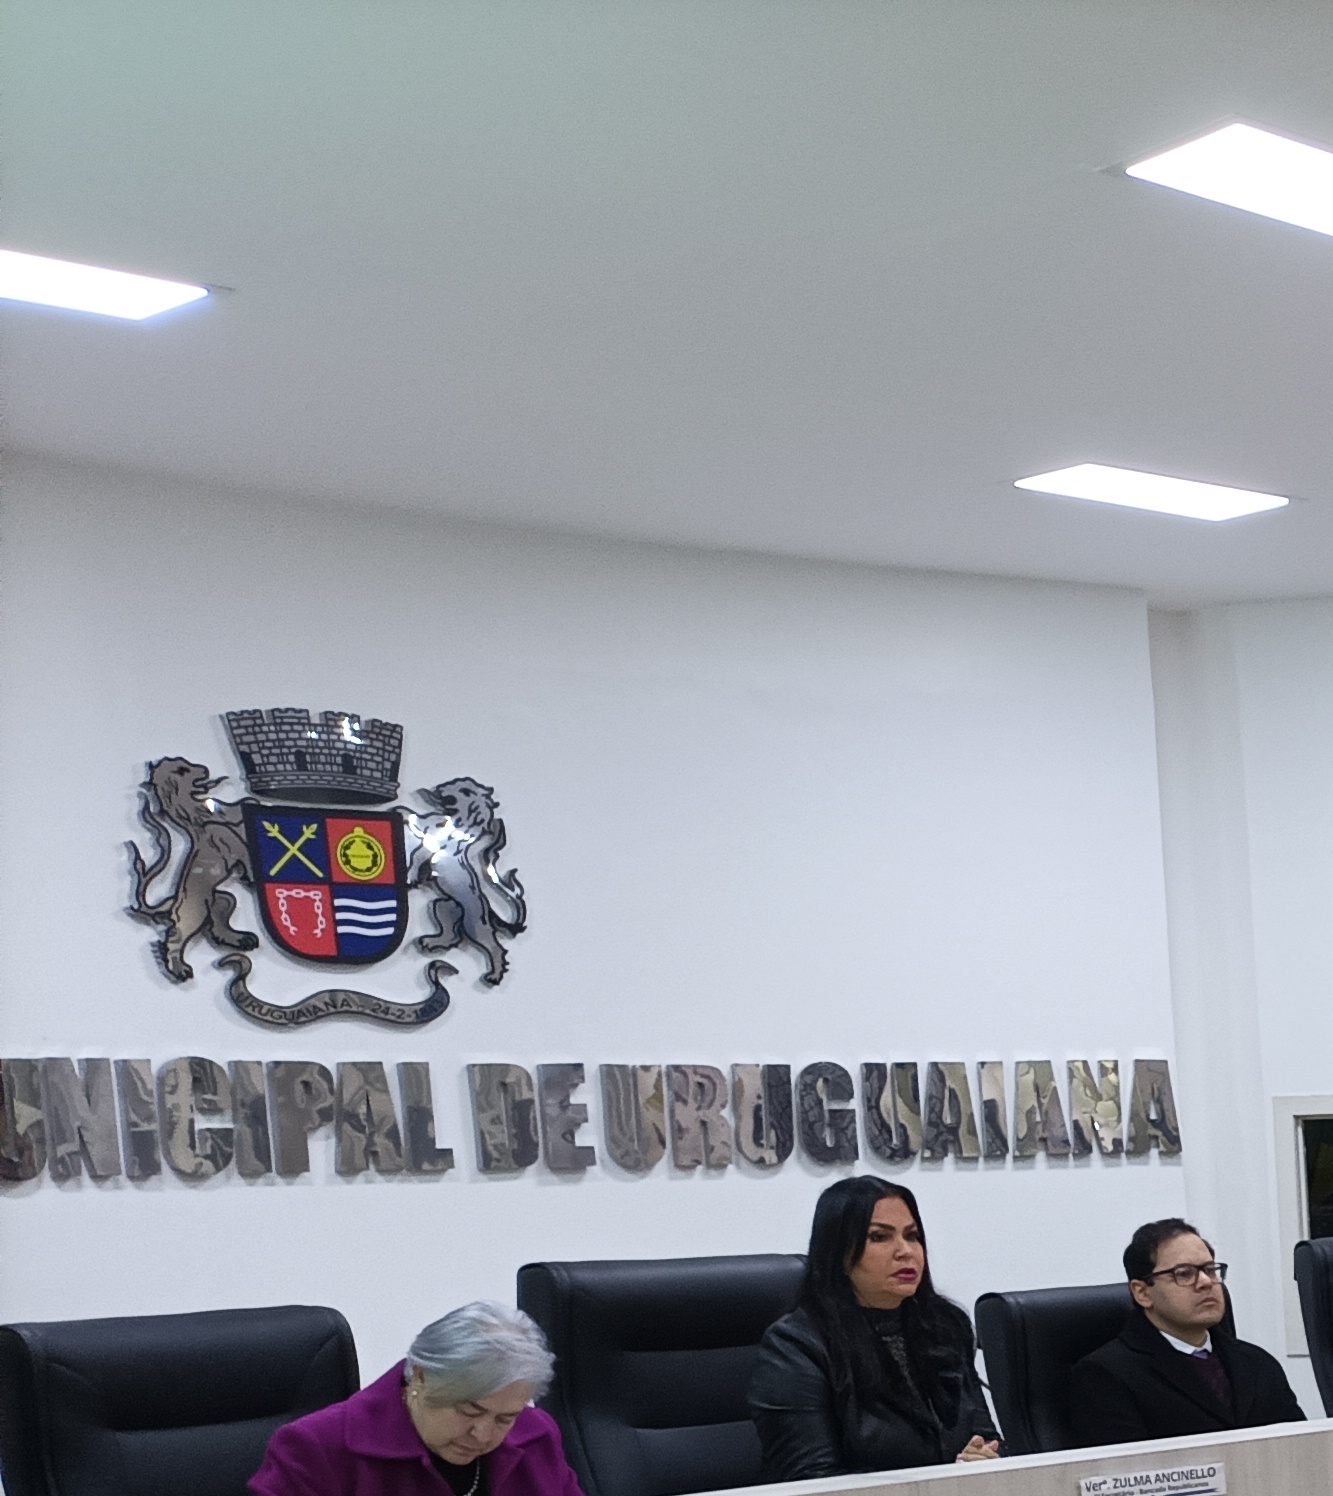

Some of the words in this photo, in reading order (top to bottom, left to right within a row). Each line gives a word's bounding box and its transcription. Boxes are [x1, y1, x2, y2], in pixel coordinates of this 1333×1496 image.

[237, 990, 352, 1022] URUGUAIANA
[466, 1062, 597, 1171] DE
[599, 1059, 1183, 1169] URUGUAIANA
[1112, 1474, 1152, 1489] ZULMA
[1154, 1466, 1216, 1484] ANCINELLO
